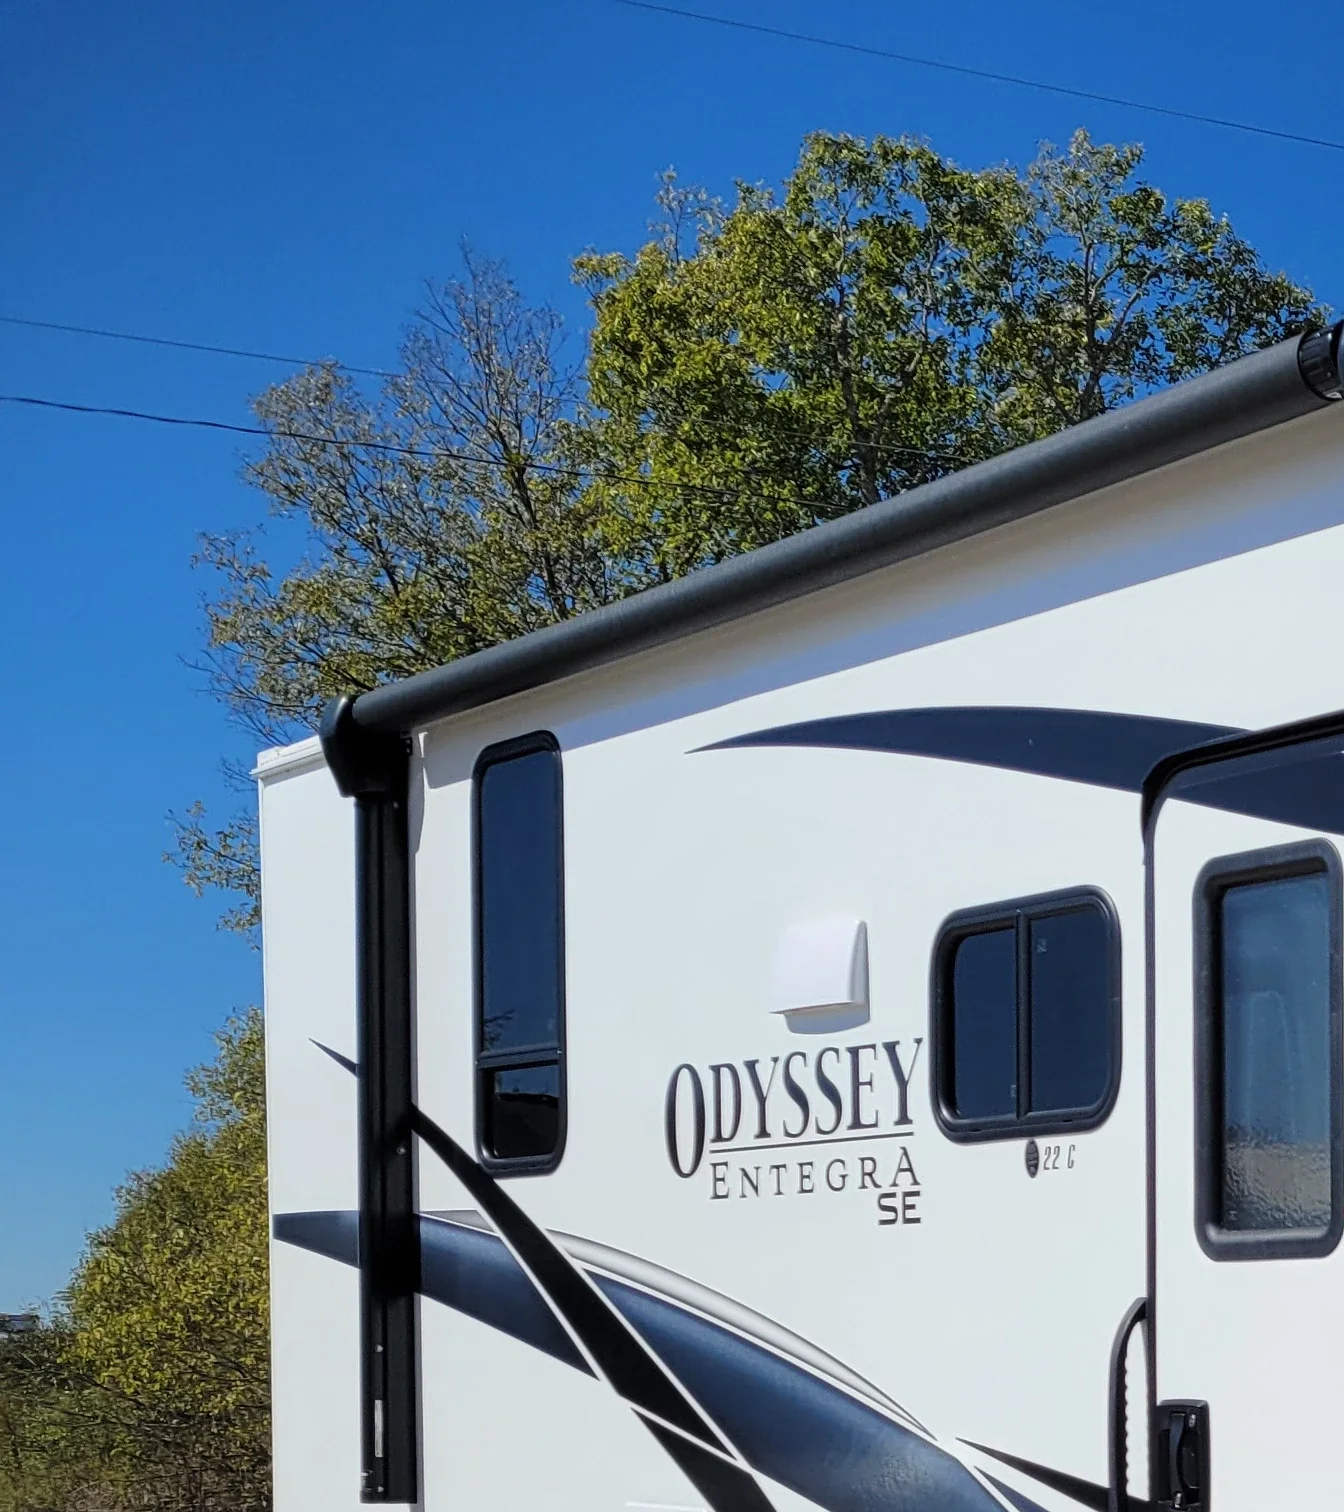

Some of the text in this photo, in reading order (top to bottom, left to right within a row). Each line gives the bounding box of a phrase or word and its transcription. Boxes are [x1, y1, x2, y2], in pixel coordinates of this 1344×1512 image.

[664, 1037, 923, 1179] ODYSSEY
[709, 1146, 921, 1200] ENTEGRA
[1043, 1145, 1060, 1171] 22
[878, 1190, 922, 1226] SE
